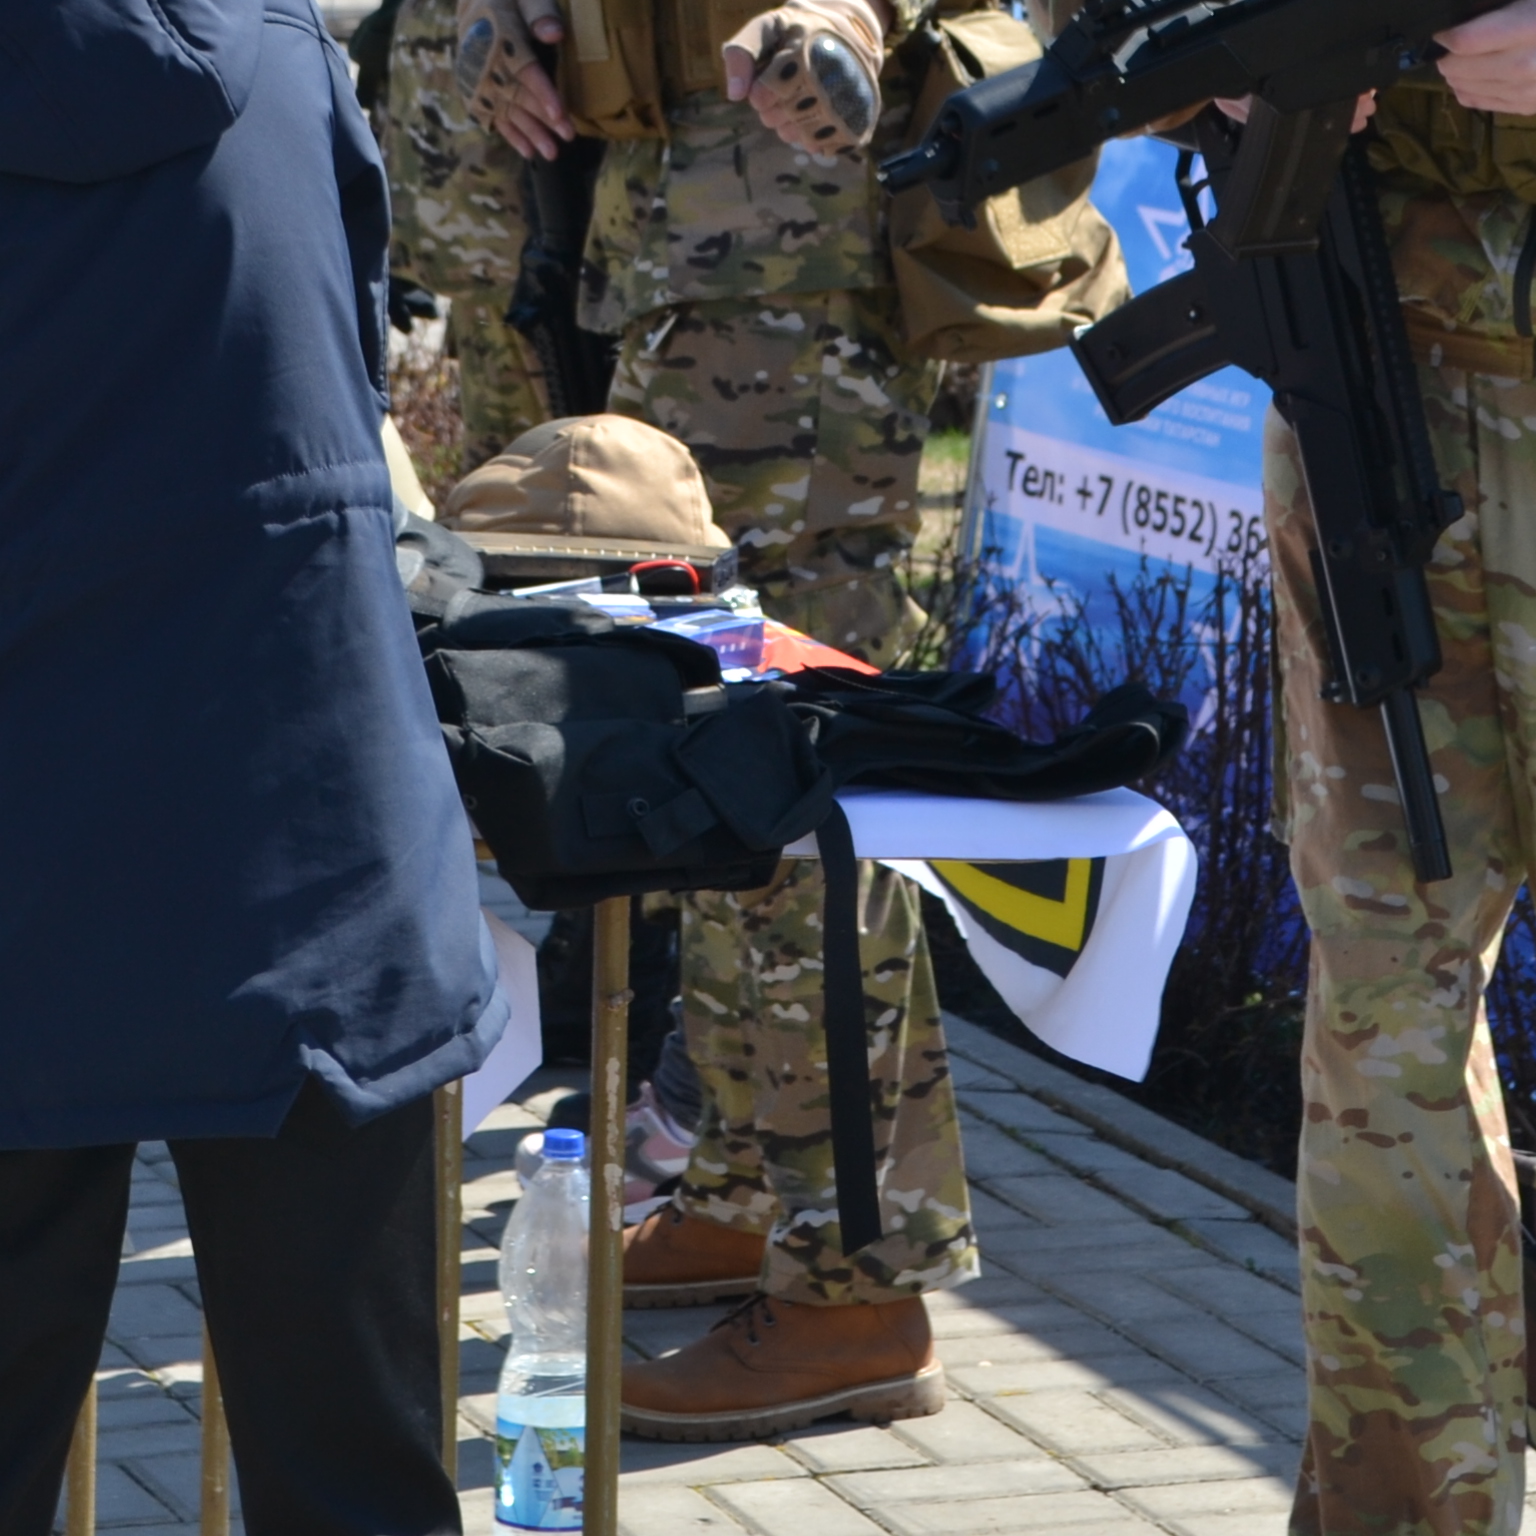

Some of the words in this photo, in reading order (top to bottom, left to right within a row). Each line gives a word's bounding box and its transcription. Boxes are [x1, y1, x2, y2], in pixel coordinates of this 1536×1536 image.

[1006, 450, 1064, 505] Тел:
[1075, 474, 1114, 515] +7
[1122, 480, 1217, 557] (8552)
